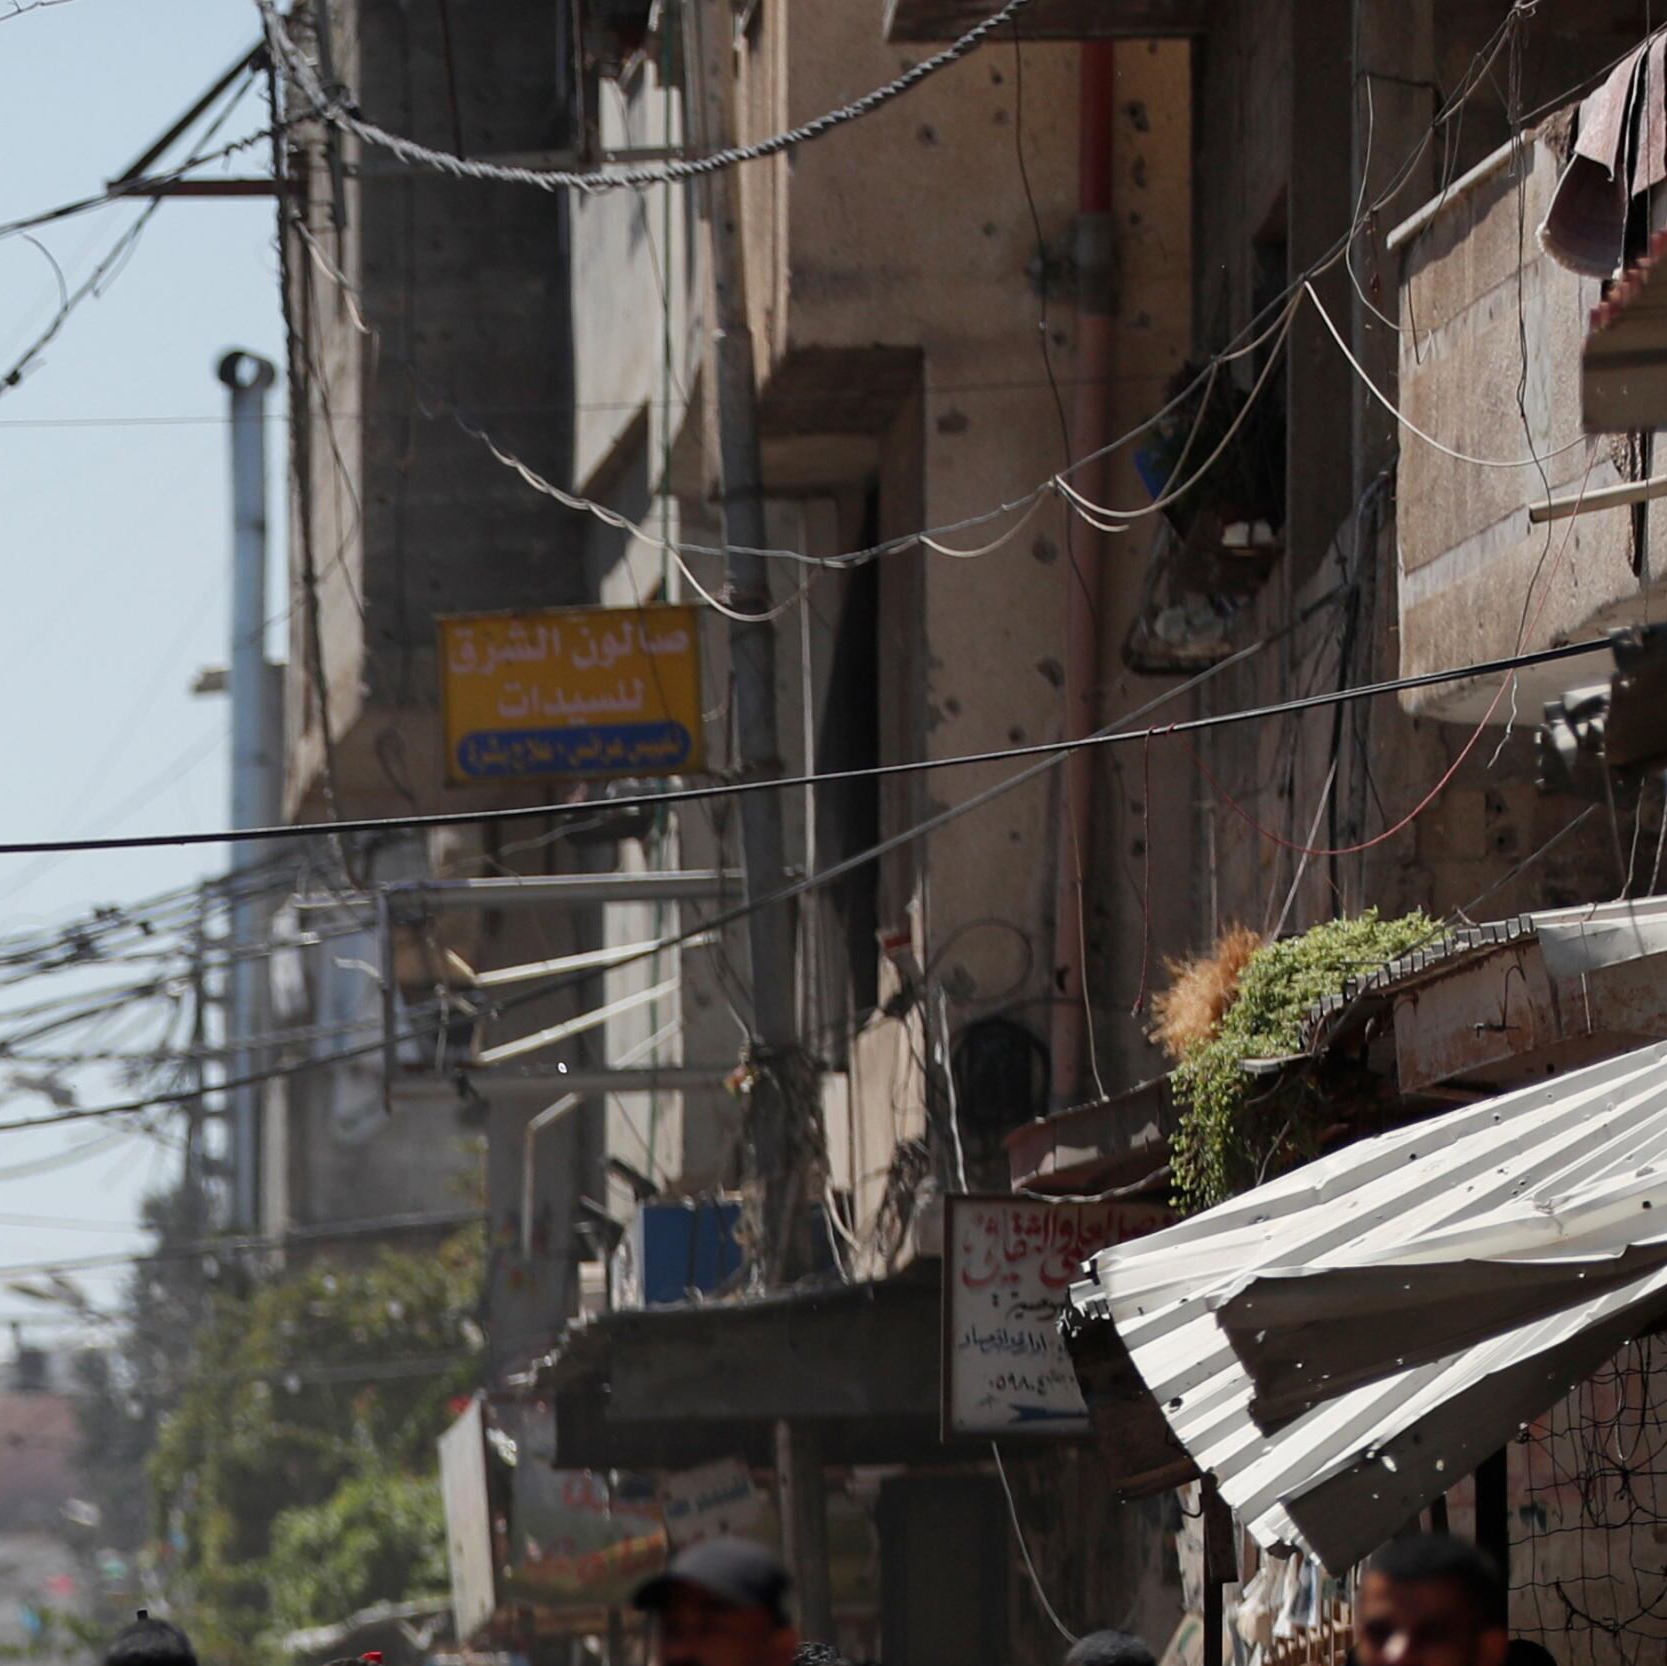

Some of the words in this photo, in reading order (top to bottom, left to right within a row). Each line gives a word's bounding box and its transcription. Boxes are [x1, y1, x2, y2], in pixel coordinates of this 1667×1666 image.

[449, 622, 562, 676] الشرق
[570, 619, 690, 670] صالون
[496, 677, 646, 726] للسيدات
